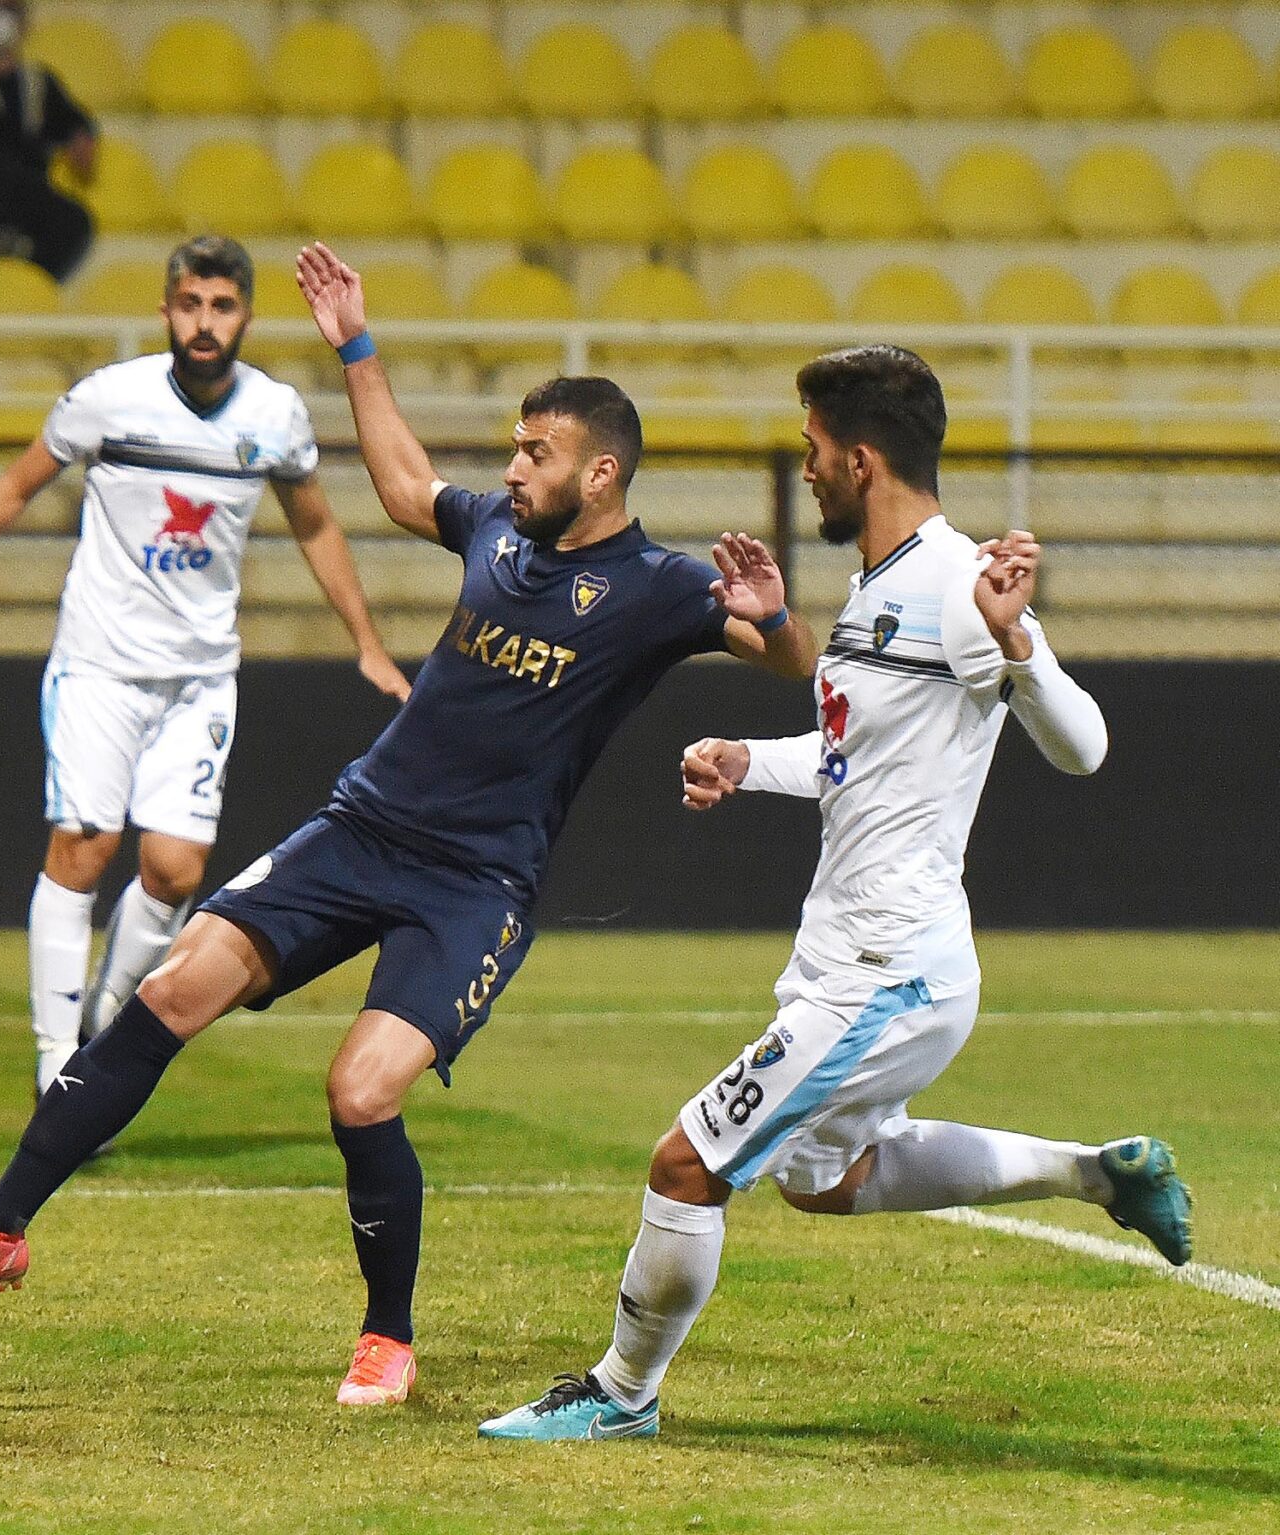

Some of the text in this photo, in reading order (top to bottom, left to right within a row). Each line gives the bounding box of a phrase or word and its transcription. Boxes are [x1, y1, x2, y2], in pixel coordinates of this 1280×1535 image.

[143, 544, 213, 573] TECO
[468, 953, 500, 1010] 3
[716, 1059, 764, 1126] 28
